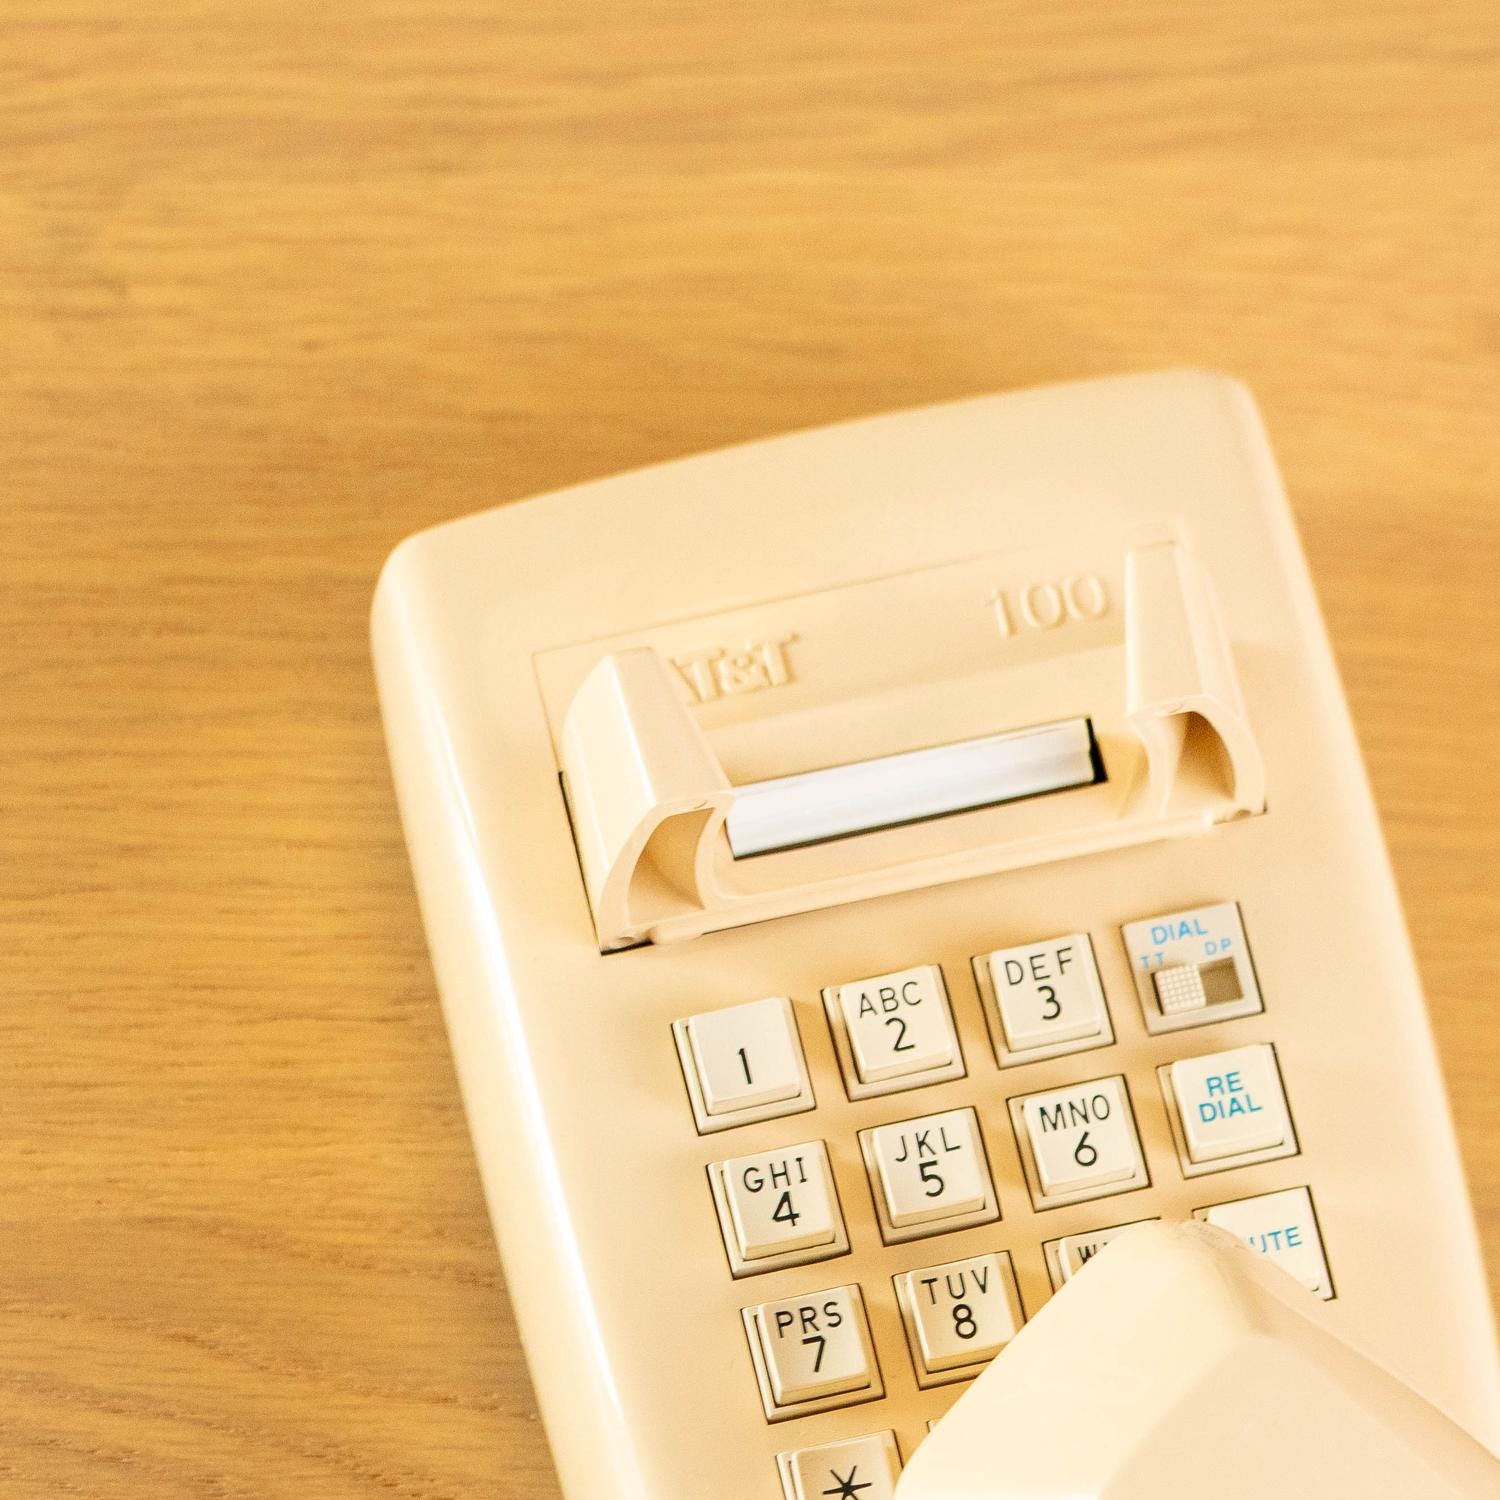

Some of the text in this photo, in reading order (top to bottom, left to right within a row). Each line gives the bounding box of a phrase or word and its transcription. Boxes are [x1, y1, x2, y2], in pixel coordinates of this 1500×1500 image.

[987, 573, 1111, 638] 100
[667, 632, 800, 704] T&T
[1151, 918, 1209, 946] DIAL
[1204, 937, 1232, 956] DP
[1004, 946, 1073, 986] DEF
[859, 981, 922, 1018] ABC
[1037, 985, 1061, 1021] 3
[885, 1017, 915, 1052] 2
[738, 1047, 754, 1086] 1
[1205, 1071, 1244, 1097] RE
[1039, 1094, 1111, 1133] MNO
[1200, 1094, 1263, 1123] DIAL
[895, 1127, 961, 1163] JKL
[1074, 1131, 1098, 1167] 6
[743, 1156, 808, 1193] GHI
[918, 1160, 945, 1198] 5
[772, 1190, 800, 1227] 4
[1248, 1226, 1303, 1253] UTE
[920, 1266, 989, 1305] TUV
[774, 1301, 842, 1338] PRS
[952, 1303, 978, 1340] 8
[801, 1335, 826, 1373] 7
